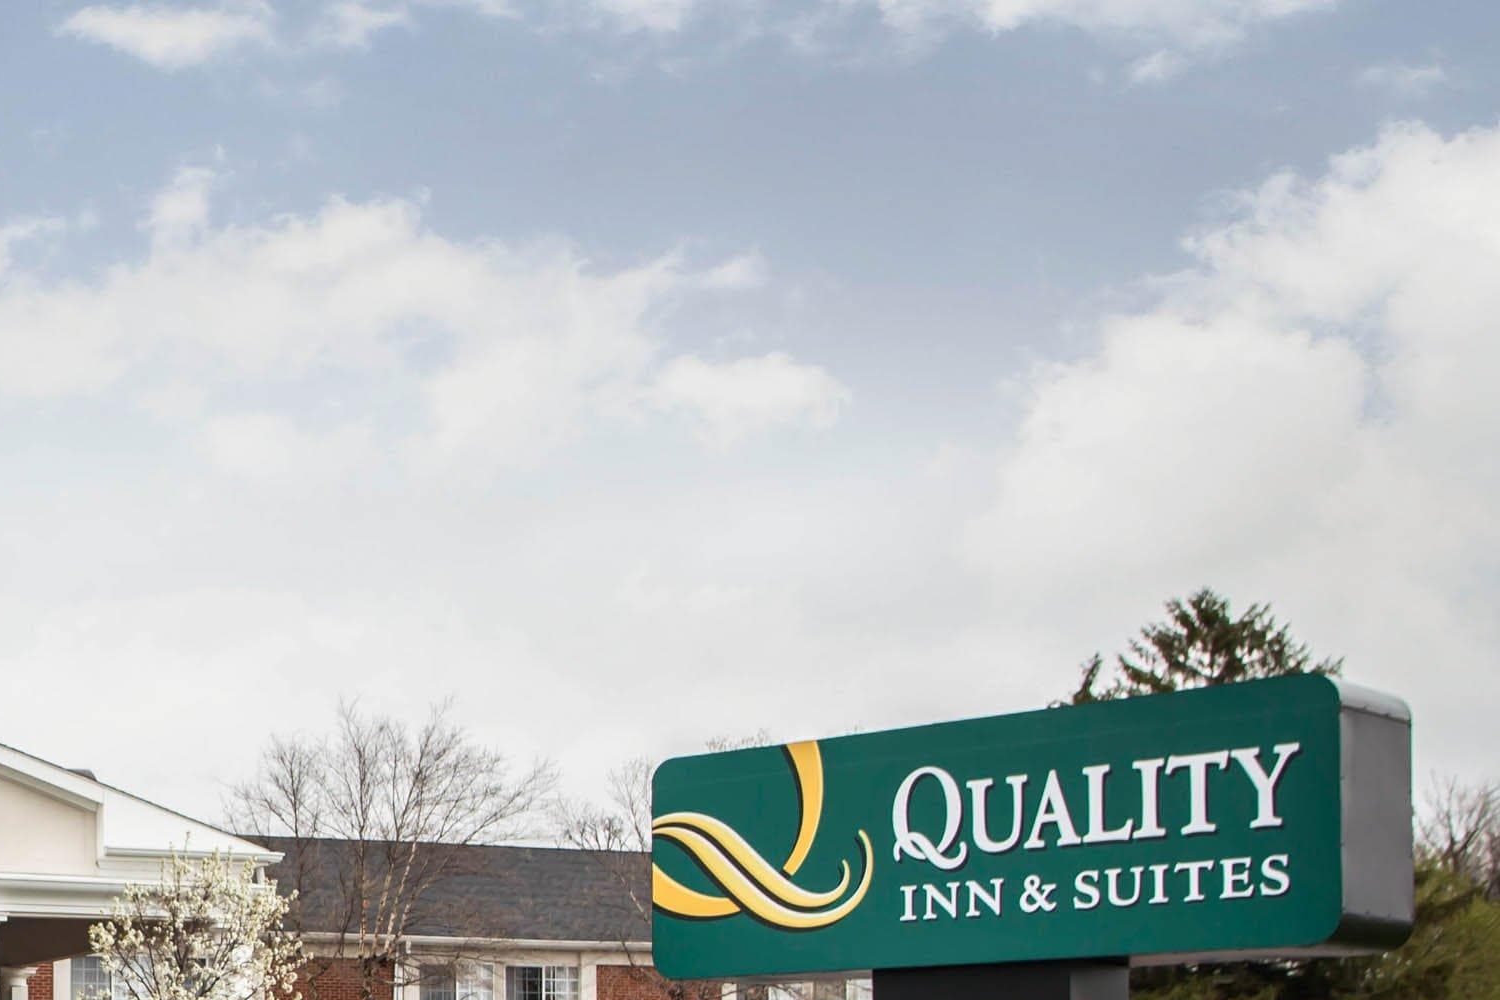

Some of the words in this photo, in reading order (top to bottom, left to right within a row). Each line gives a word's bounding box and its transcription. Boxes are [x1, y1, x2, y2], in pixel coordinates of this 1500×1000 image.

[892, 742, 1299, 870] QUALITY
[900, 879, 1003, 922] INN
[1020, 874, 1057, 912] &
[1073, 854, 1291, 909] SUITES
